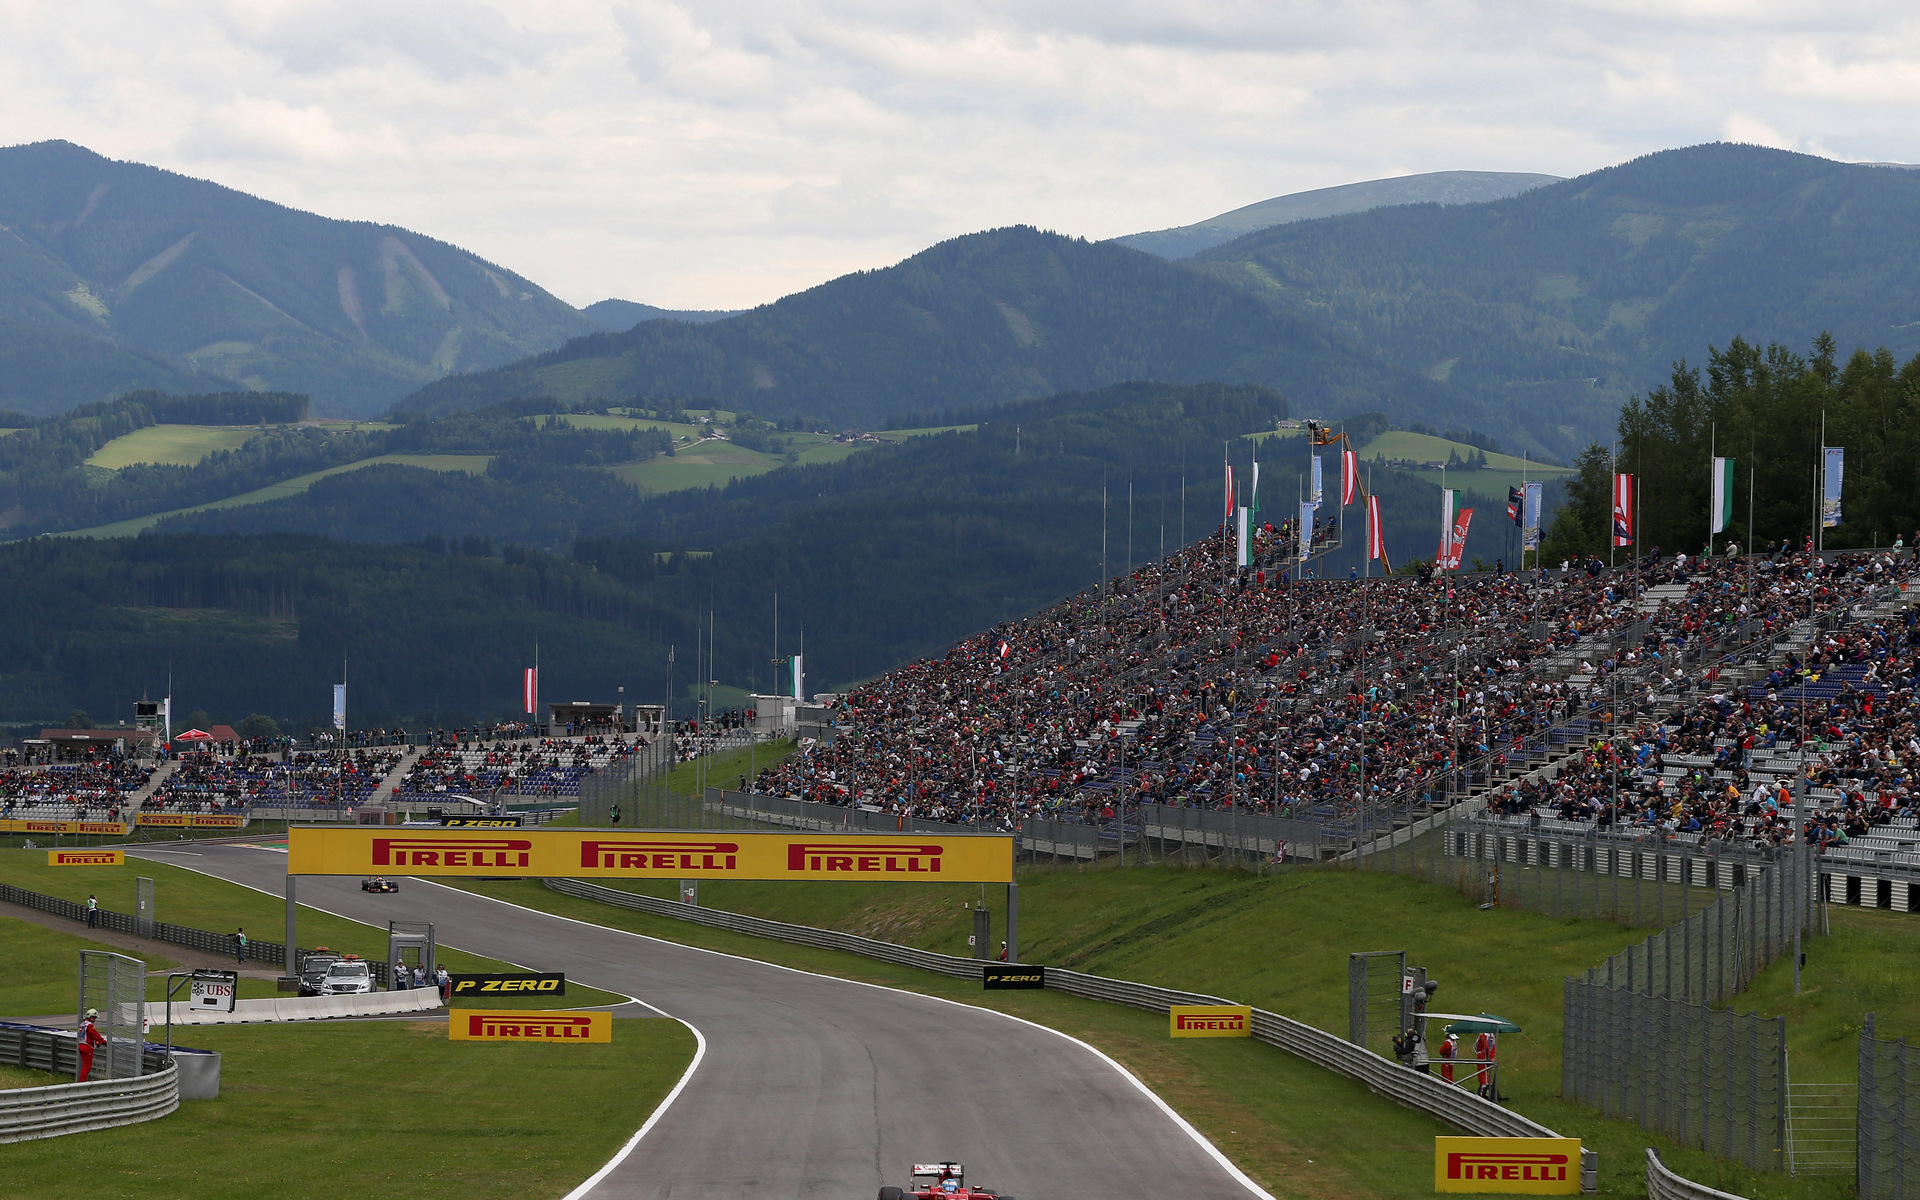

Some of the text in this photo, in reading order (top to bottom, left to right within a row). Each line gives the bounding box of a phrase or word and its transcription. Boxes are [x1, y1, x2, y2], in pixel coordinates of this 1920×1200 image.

[446, 819, 517, 828] P ZERO
[58, 853, 115, 864] PIRELLI
[372, 838, 532, 867] PIRELLI
[581, 840, 739, 870] PIRELLI
[787, 843, 944, 872] PIRELLI
[207, 984, 231, 997] UBS
[455, 979, 560, 992] P ZERO
[1405, 980, 1412, 990] F
[468, 1015, 592, 1038] PIRELLI
[1177, 1014, 1244, 1030] PIRELLI
[1447, 1152, 1569, 1181] PIRELLI
